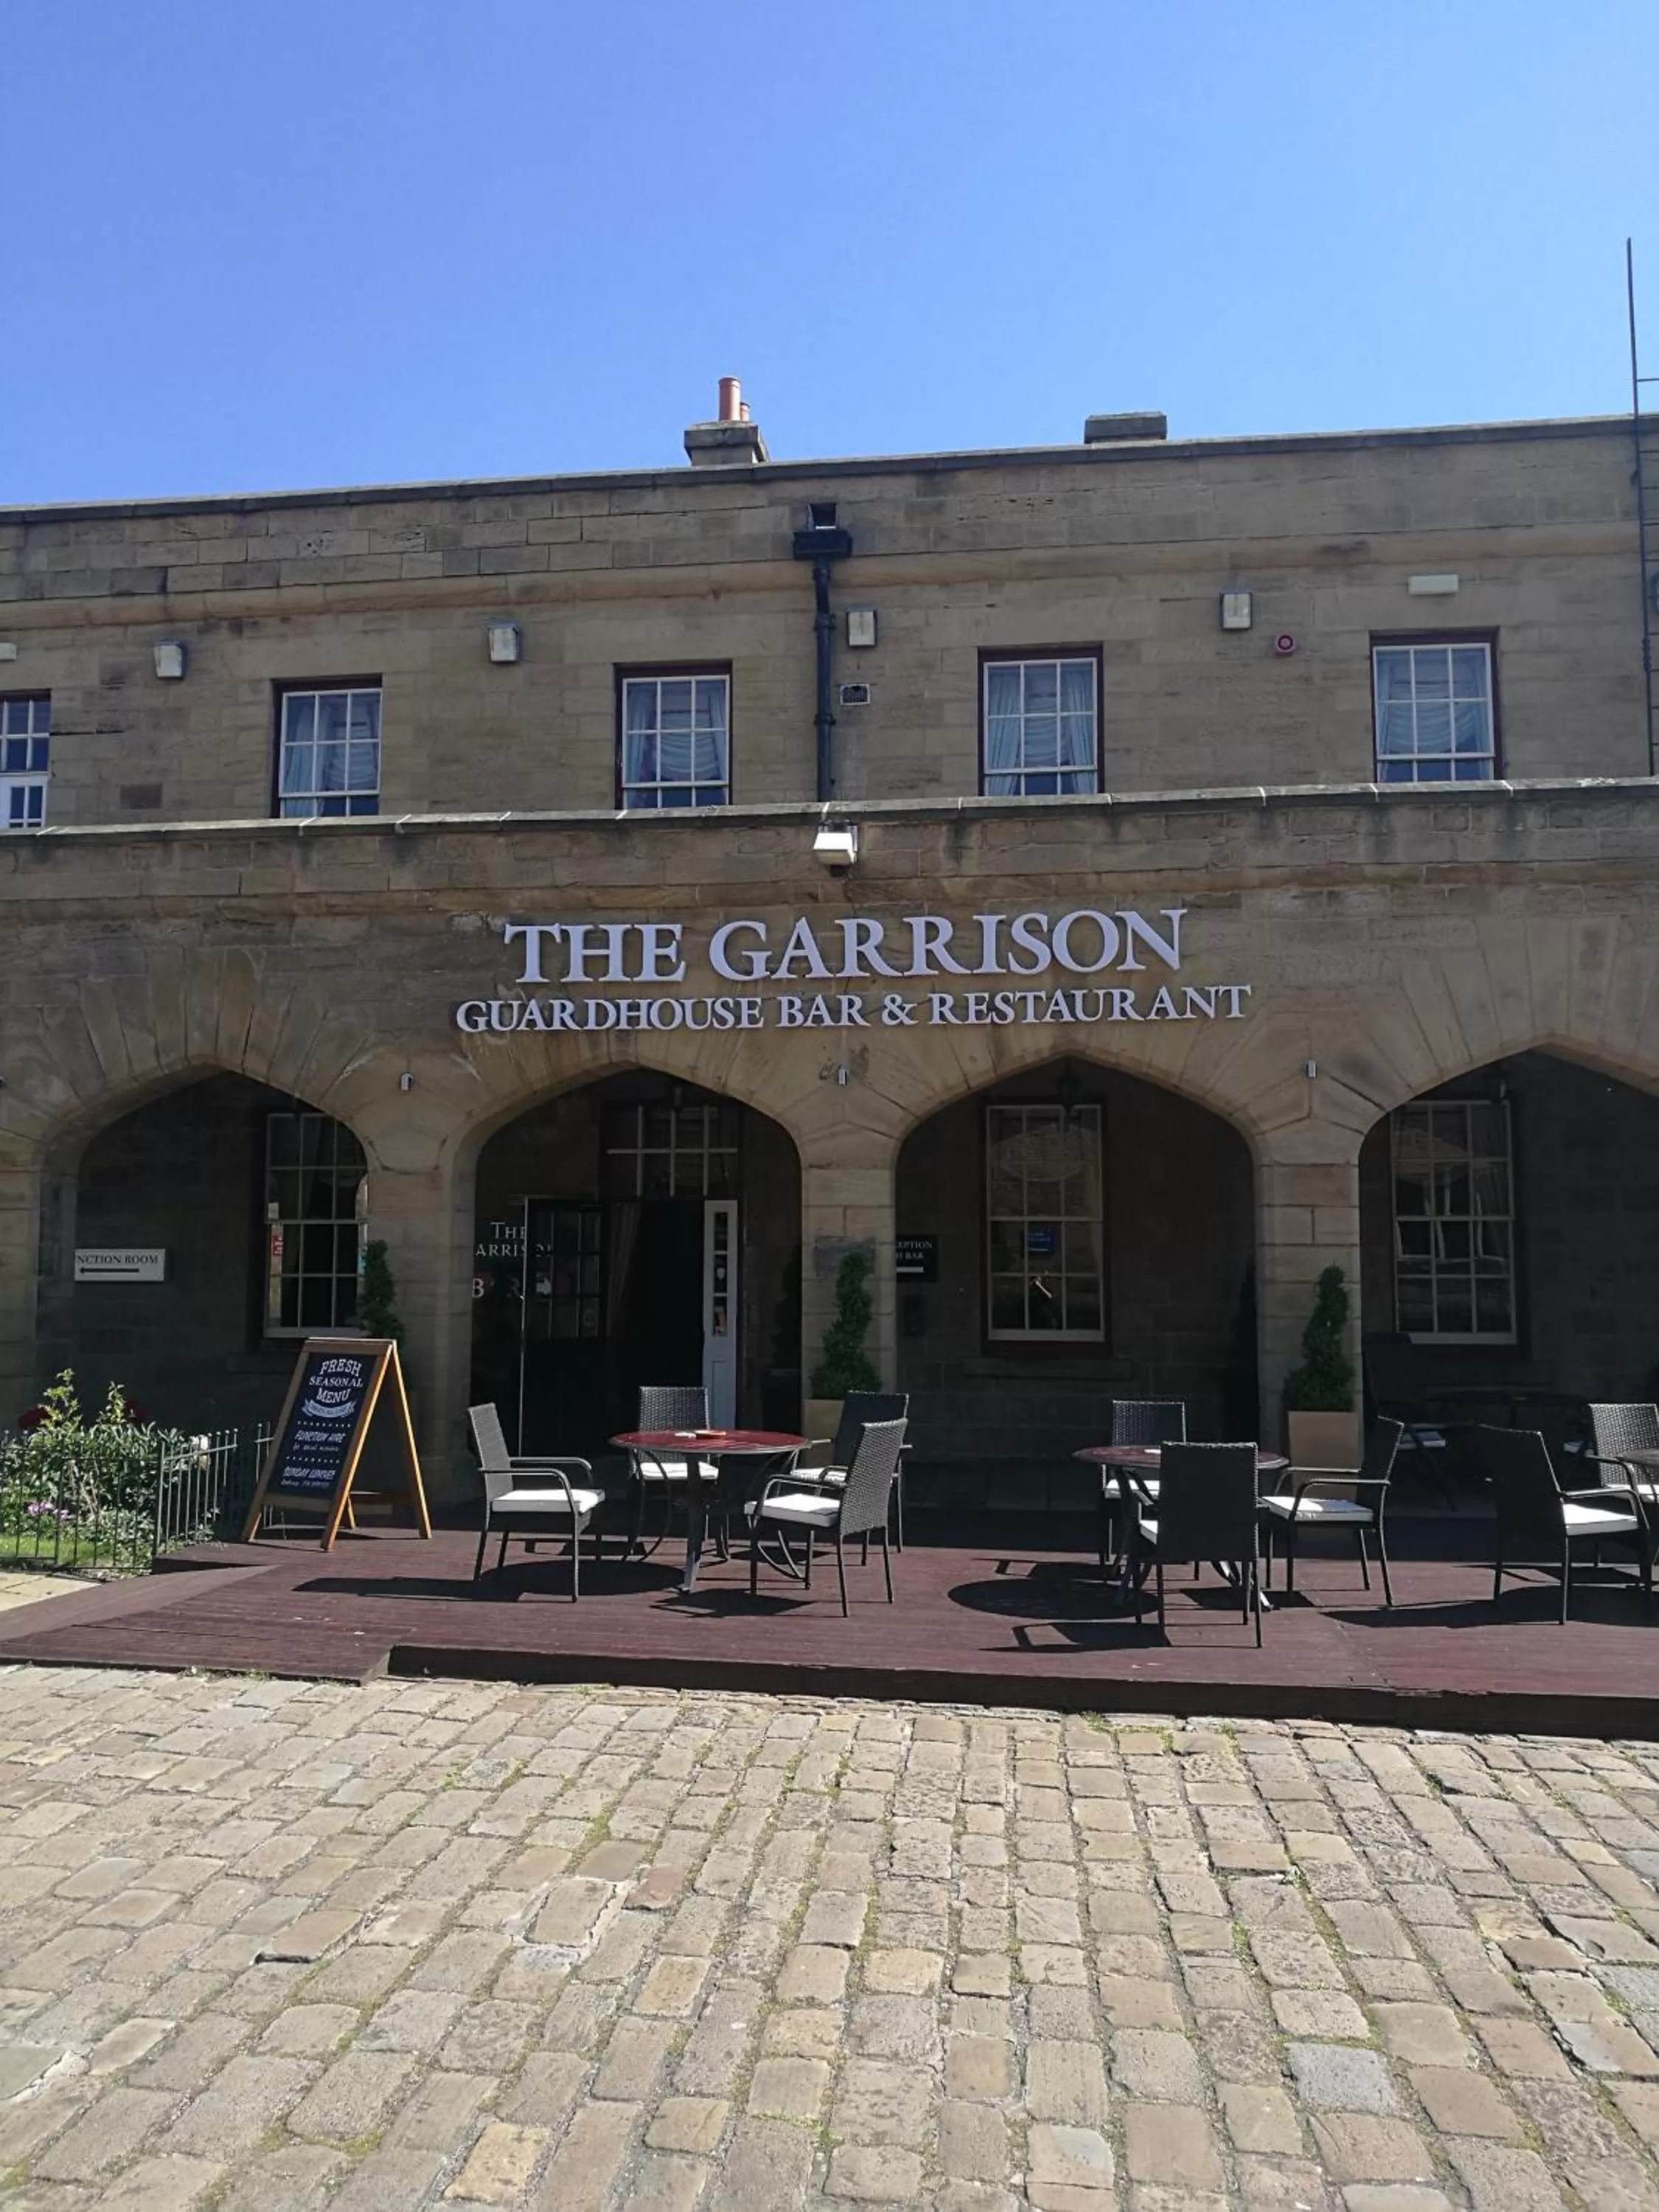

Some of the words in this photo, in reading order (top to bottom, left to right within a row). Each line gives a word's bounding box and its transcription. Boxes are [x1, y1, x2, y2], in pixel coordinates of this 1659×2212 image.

[504, 922, 687, 983] THE
[709, 908, 1188, 981] GARRISON
[456, 996, 765, 1032] GUARDHOUSE
[776, 994, 872, 1029] BAR
[882, 994, 919, 1026] &
[928, 984, 1253, 1026] RESTAURANT
[125, 1255, 159, 1265] ROOM
[319, 1358, 362, 1377] FRESH
[309, 1375, 364, 1388] SEASONAL
[316, 1387, 352, 1403] MENU
